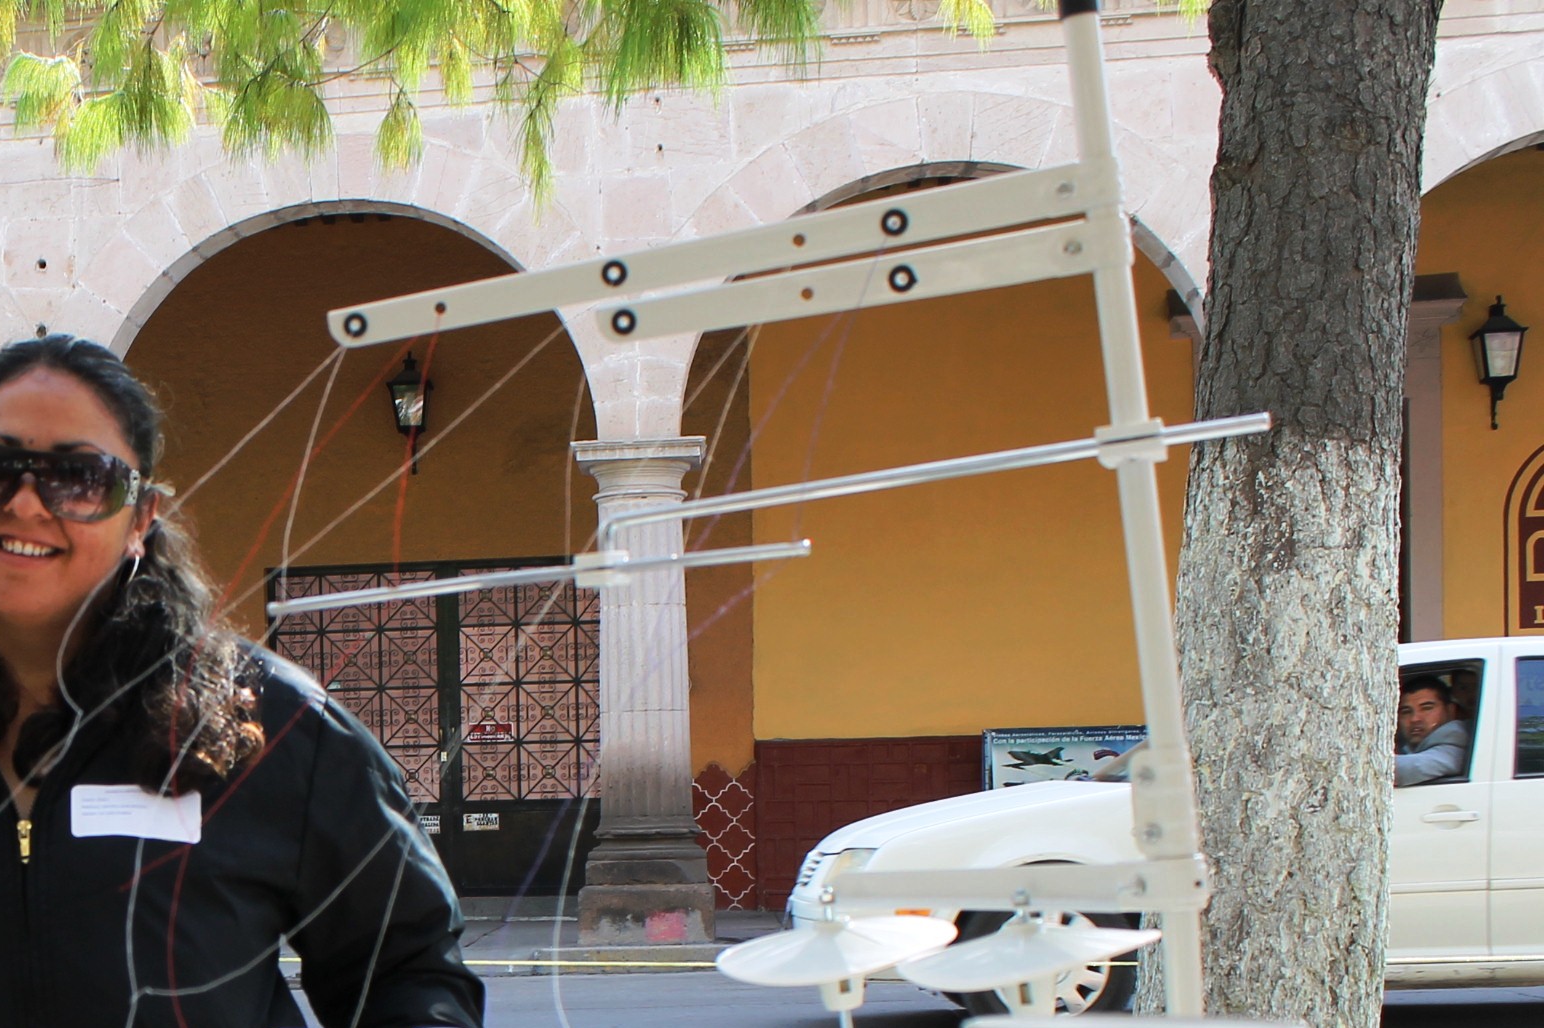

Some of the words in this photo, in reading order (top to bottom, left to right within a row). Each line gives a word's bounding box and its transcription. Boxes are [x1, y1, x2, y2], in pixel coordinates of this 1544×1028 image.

[1016, 735, 1060, 744] participación
[1104, 733, 1124, 741] Aérea
[1126, 733, 1147, 741] Mexic
